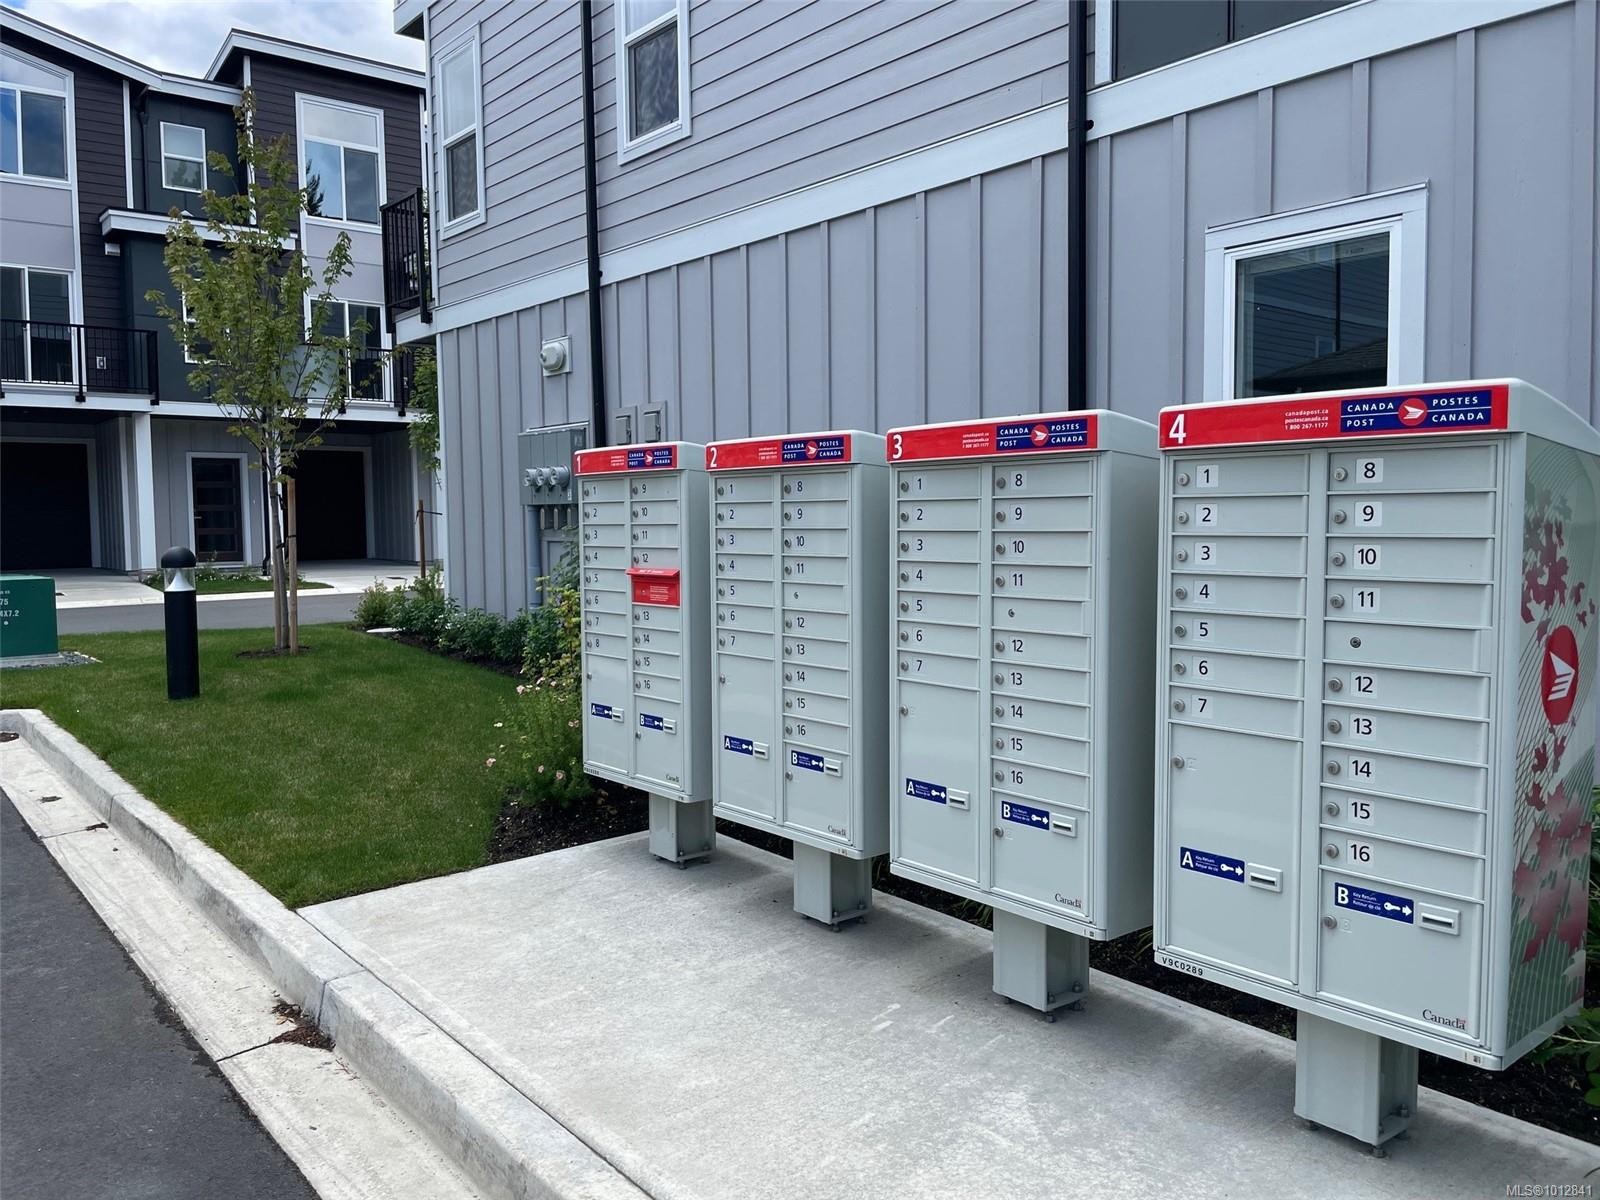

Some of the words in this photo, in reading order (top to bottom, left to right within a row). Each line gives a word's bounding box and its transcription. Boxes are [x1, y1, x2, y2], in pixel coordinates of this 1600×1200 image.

[1433, 397, 1478, 406] POSTES
[1285, 409, 1328, 417] canadapost.ca
[1347, 403, 1394, 412] CANADA
[1347, 419, 1374, 427] POST
[1432, 413, 1484, 422] CANADA
[1169, 414, 1186, 444] 4
[892, 434, 902, 459] 3
[711, 448, 717, 467] 2
[577, 456, 580, 472] 1
[1364, 462, 1375, 478] 8
[1015, 474, 1022, 486] 8
[1203, 469, 1210, 483] 1
[642, 484, 646, 493] 9
[730, 485, 733, 494] 1
[797, 481, 803, 492] 8
[918, 479, 922, 490] 1
[593, 487, 596, 495] 1
[594, 509, 597, 517] 2
[642, 507, 648, 516] 10
[730, 510, 734, 520] 2
[797, 509, 803, 519] 9
[917, 509, 923, 520] 2
[1015, 508, 1022, 520] 9
[1202, 508, 1211, 522] 2
[1363, 506, 1374, 522] 9
[594, 530, 597, 539] 3
[642, 531, 648, 539] 11
[730, 535, 734, 545] 3
[797, 536, 805, 547] 10
[917, 539, 923, 551] 3
[1013, 541, 1024, 553] 10
[594, 552, 598, 560] 4
[643, 554, 648, 563] 12
[1201, 546, 1211, 560] 3
[1358, 549, 1377, 565] 10
[730, 561, 735, 570] 4
[797, 564, 804, 574] 11
[595, 574, 598, 582] 5
[916, 570, 922, 581] 4
[1013, 574, 1023, 586] 11
[731, 586, 735, 595] 5
[1200, 584, 1210, 599] 4
[595, 596, 598, 604] 6
[1357, 591, 1375, 608] 11
[917, 600, 922, 611] 5
[596, 617, 599, 625] 7
[643, 611, 649, 621] 13
[731, 611, 735, 620] 6
[797, 618, 805, 628] 12
[1200, 623, 1208, 637] 5
[644, 634, 649, 644] 14
[731, 636, 735, 646] 7
[917, 630, 922, 642] 6
[596, 639, 600, 648] 8
[1012, 640, 1023, 652] 12
[797, 644, 805, 655] 13
[644, 657, 650, 666] 15
[916, 660, 923, 671] 7
[1199, 661, 1208, 675] 6
[797, 671, 805, 682] 14
[1011, 673, 1023, 685] 13
[644, 680, 650, 689] 16
[1355, 676, 1373, 693] 12
[797, 698, 805, 709] 15
[1198, 699, 1207, 713] 7
[1011, 705, 1023, 718] 14
[641, 715, 644, 725] B
[797, 725, 805, 736] 16
[1354, 719, 1372, 735] 13
[725, 738, 731, 749] A
[1011, 738, 1023, 751] 15
[793, 753, 798, 764] B
[1352, 761, 1371, 778] 14
[1011, 771, 1023, 784] 16
[907, 782, 915, 794] A
[1003, 804, 1010, 818] B
[1352, 803, 1370, 820] 15
[1351, 844, 1370, 862] 16
[1182, 852, 1194, 868] A
[1055, 893, 1082, 909] Canada
[1338, 887, 1349, 904] B
[1162, 957, 1203, 976] V9C0289
[1423, 1009, 1466, 1030] Canada
